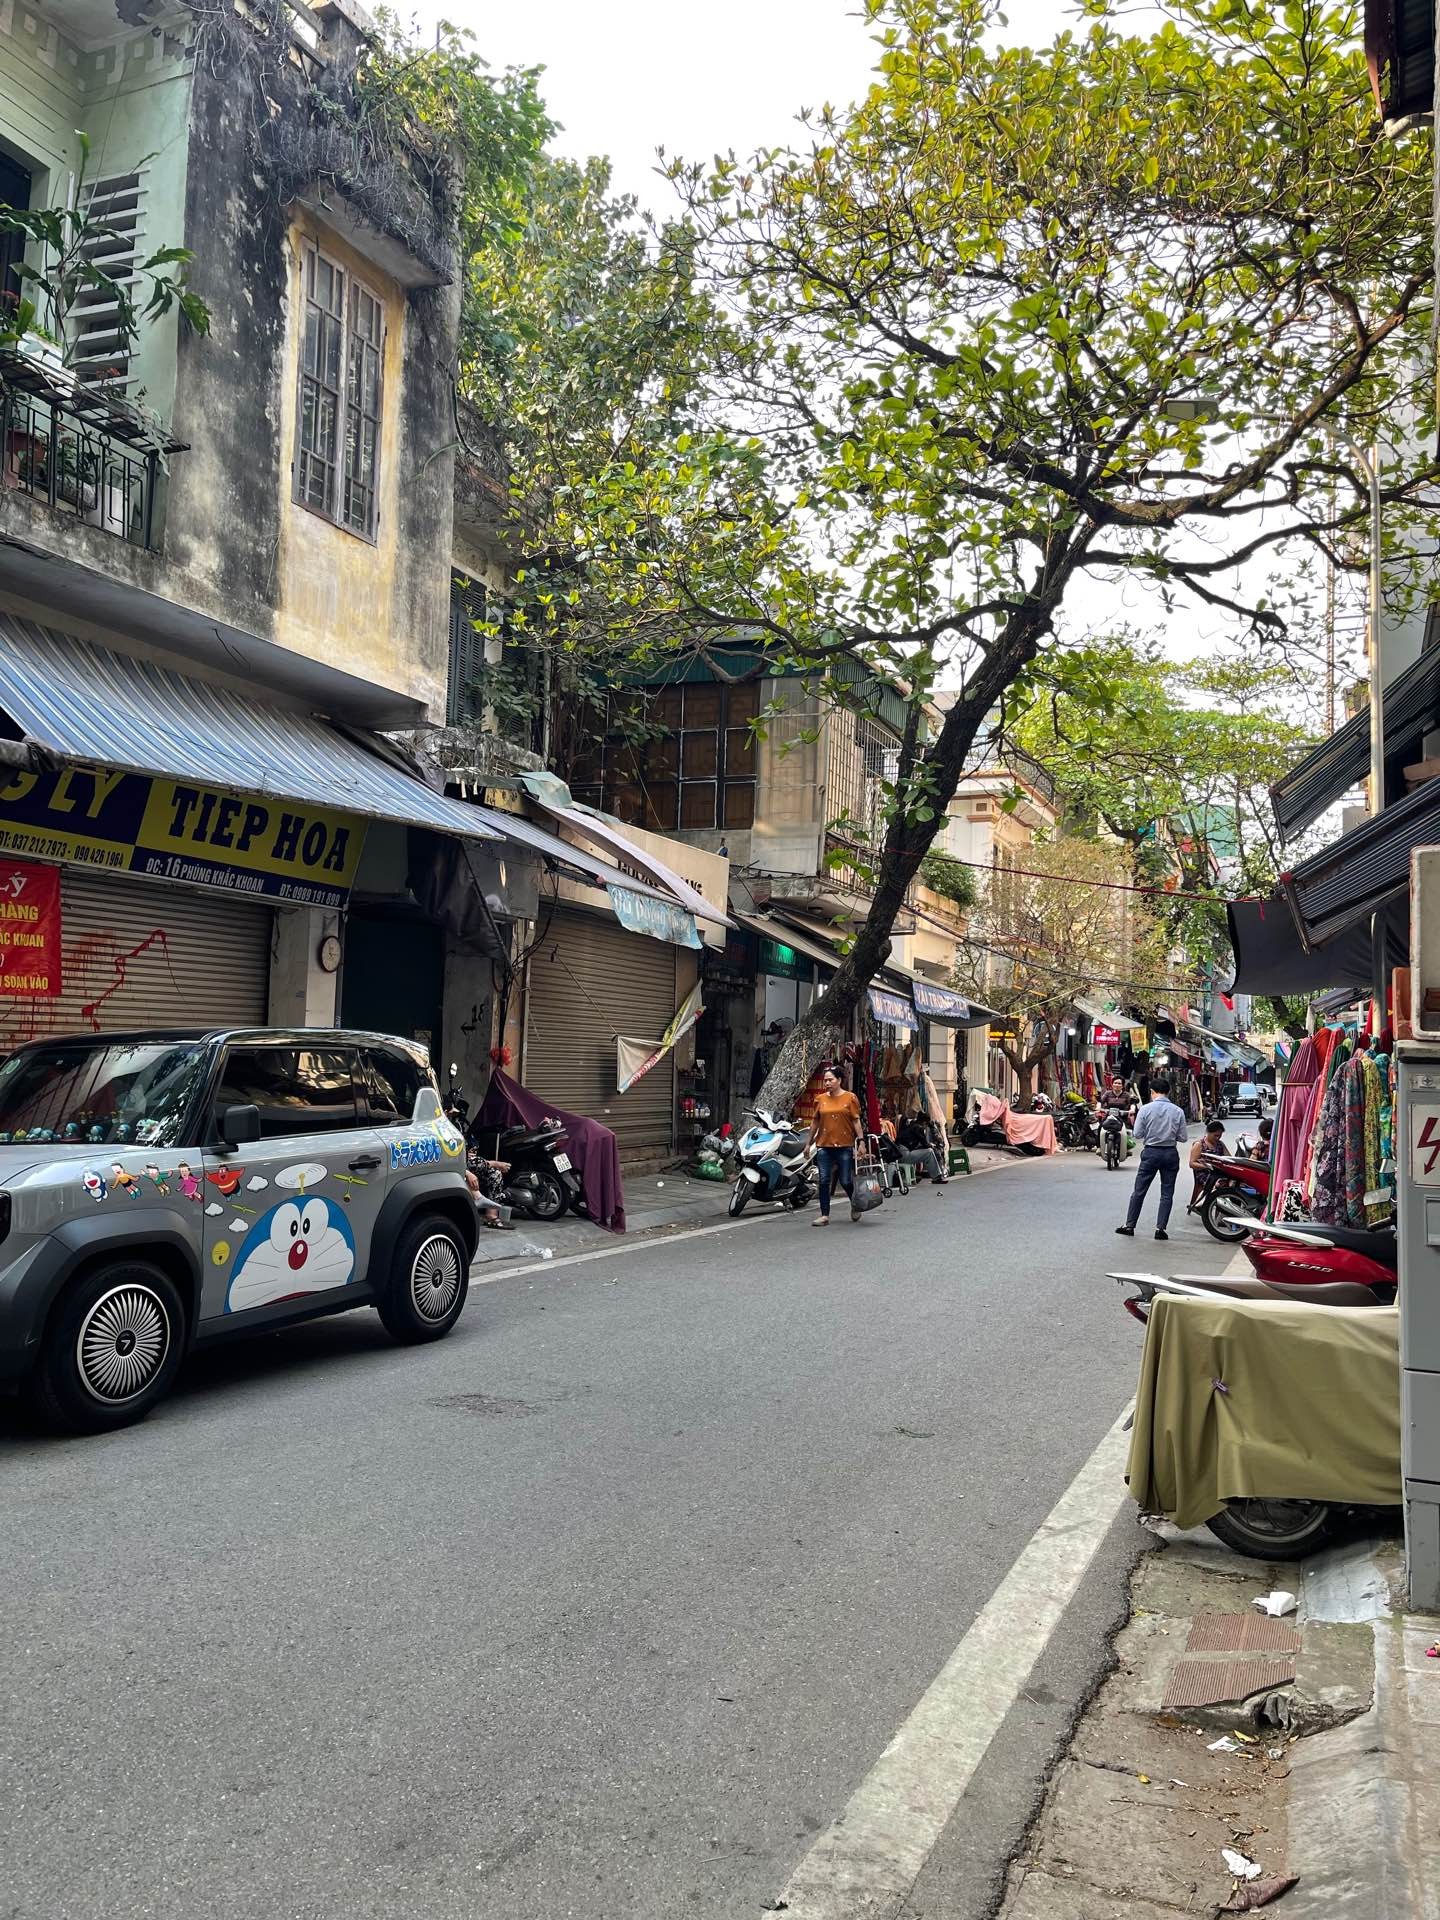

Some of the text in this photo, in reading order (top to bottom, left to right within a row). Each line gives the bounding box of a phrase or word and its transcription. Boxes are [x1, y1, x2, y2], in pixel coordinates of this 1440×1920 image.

[29, 836, 46, 853] 212
[271, 812, 350, 872] HOA
[146, 858, 163, 874] ĐC:
[165, 857, 181, 877] 16
[211, 867, 235, 887] KHẮC
[235, 873, 264, 892] KHOAN
